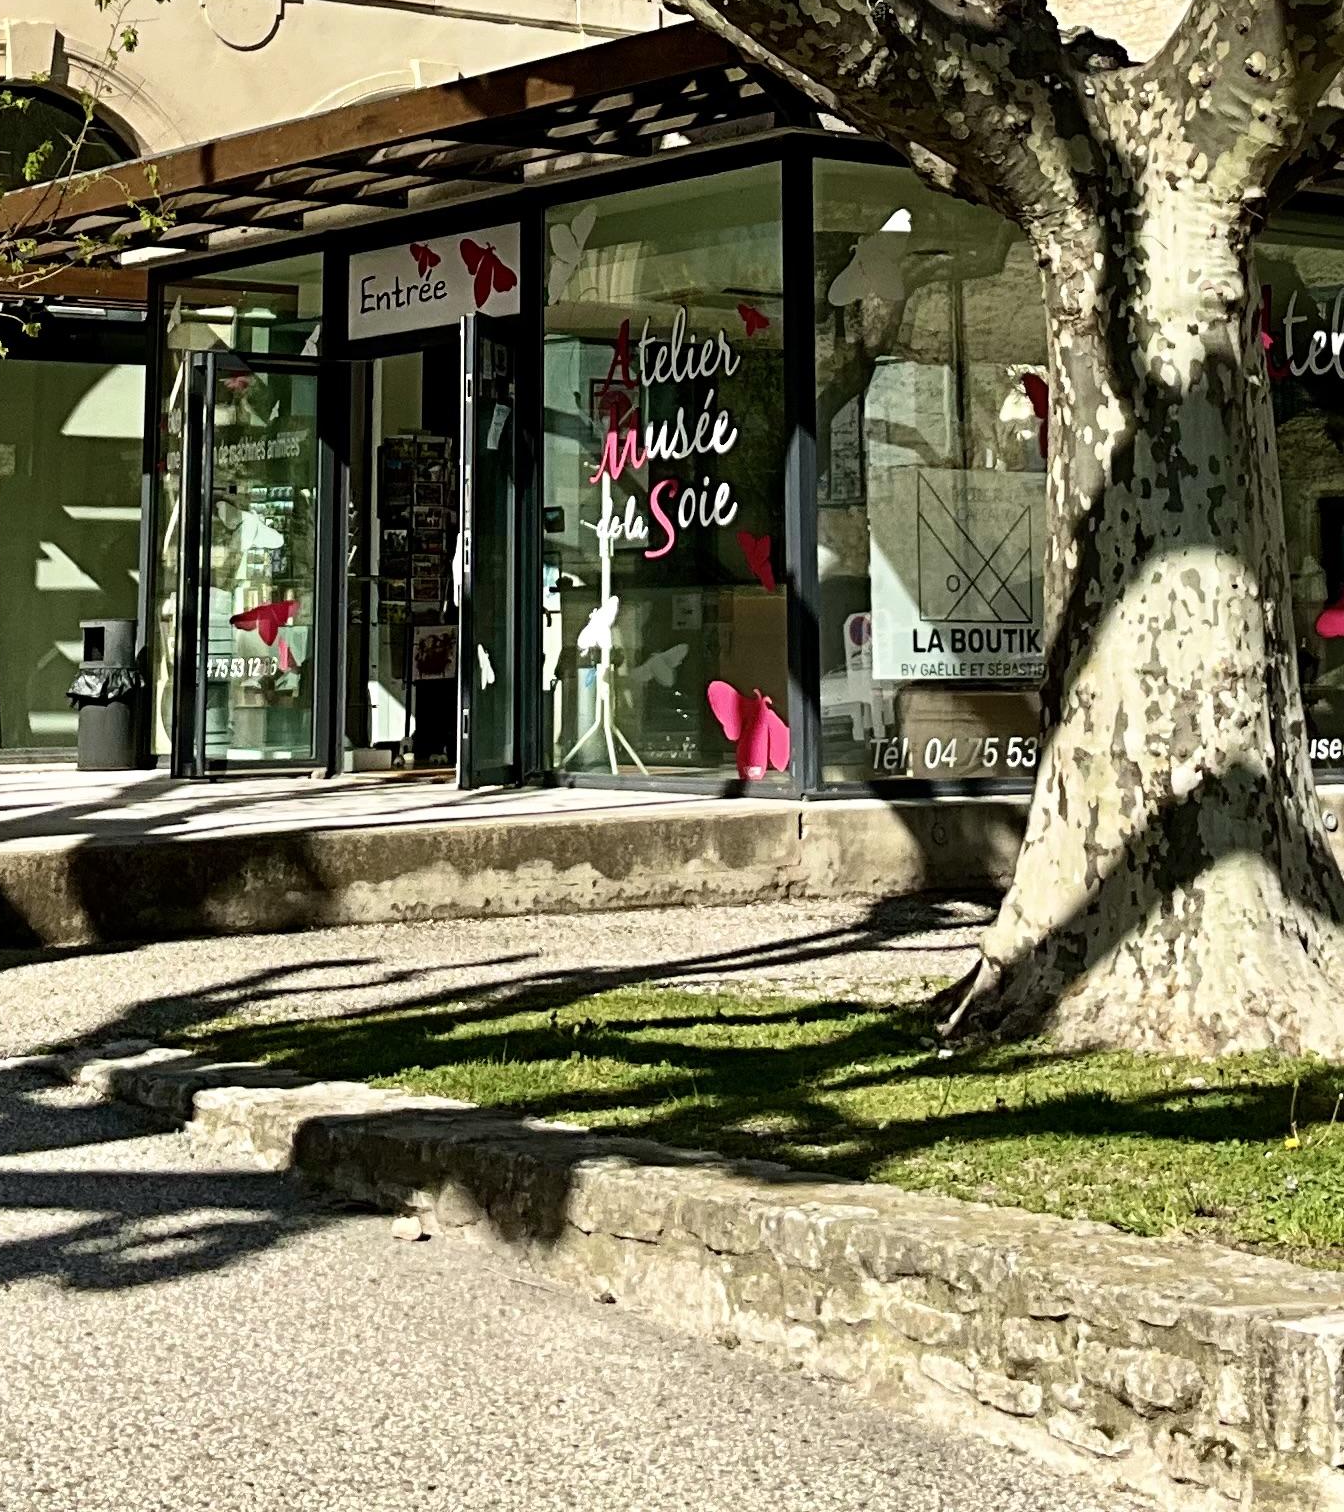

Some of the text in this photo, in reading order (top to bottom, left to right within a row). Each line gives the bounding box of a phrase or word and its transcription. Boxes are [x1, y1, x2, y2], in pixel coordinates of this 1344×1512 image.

[360, 269, 448, 314] Entrée
[594, 305, 741, 396] Atelier
[589, 388, 739, 484] Musée
[624, 495, 649, 540] la
[644, 475, 739, 559] Soie
[913, 628, 1042, 653] LA BOUTIK
[215, 658, 229, 678] 75
[230, 657, 245, 678] 53
[248, 657, 261, 677] 12
[901, 660, 1048, 676] BY GAËLLE ET SÉBASTIE
[925, 737, 958, 769] 04
[968, 737, 999, 767] 75
[1006, 736, 1038, 768] 53
